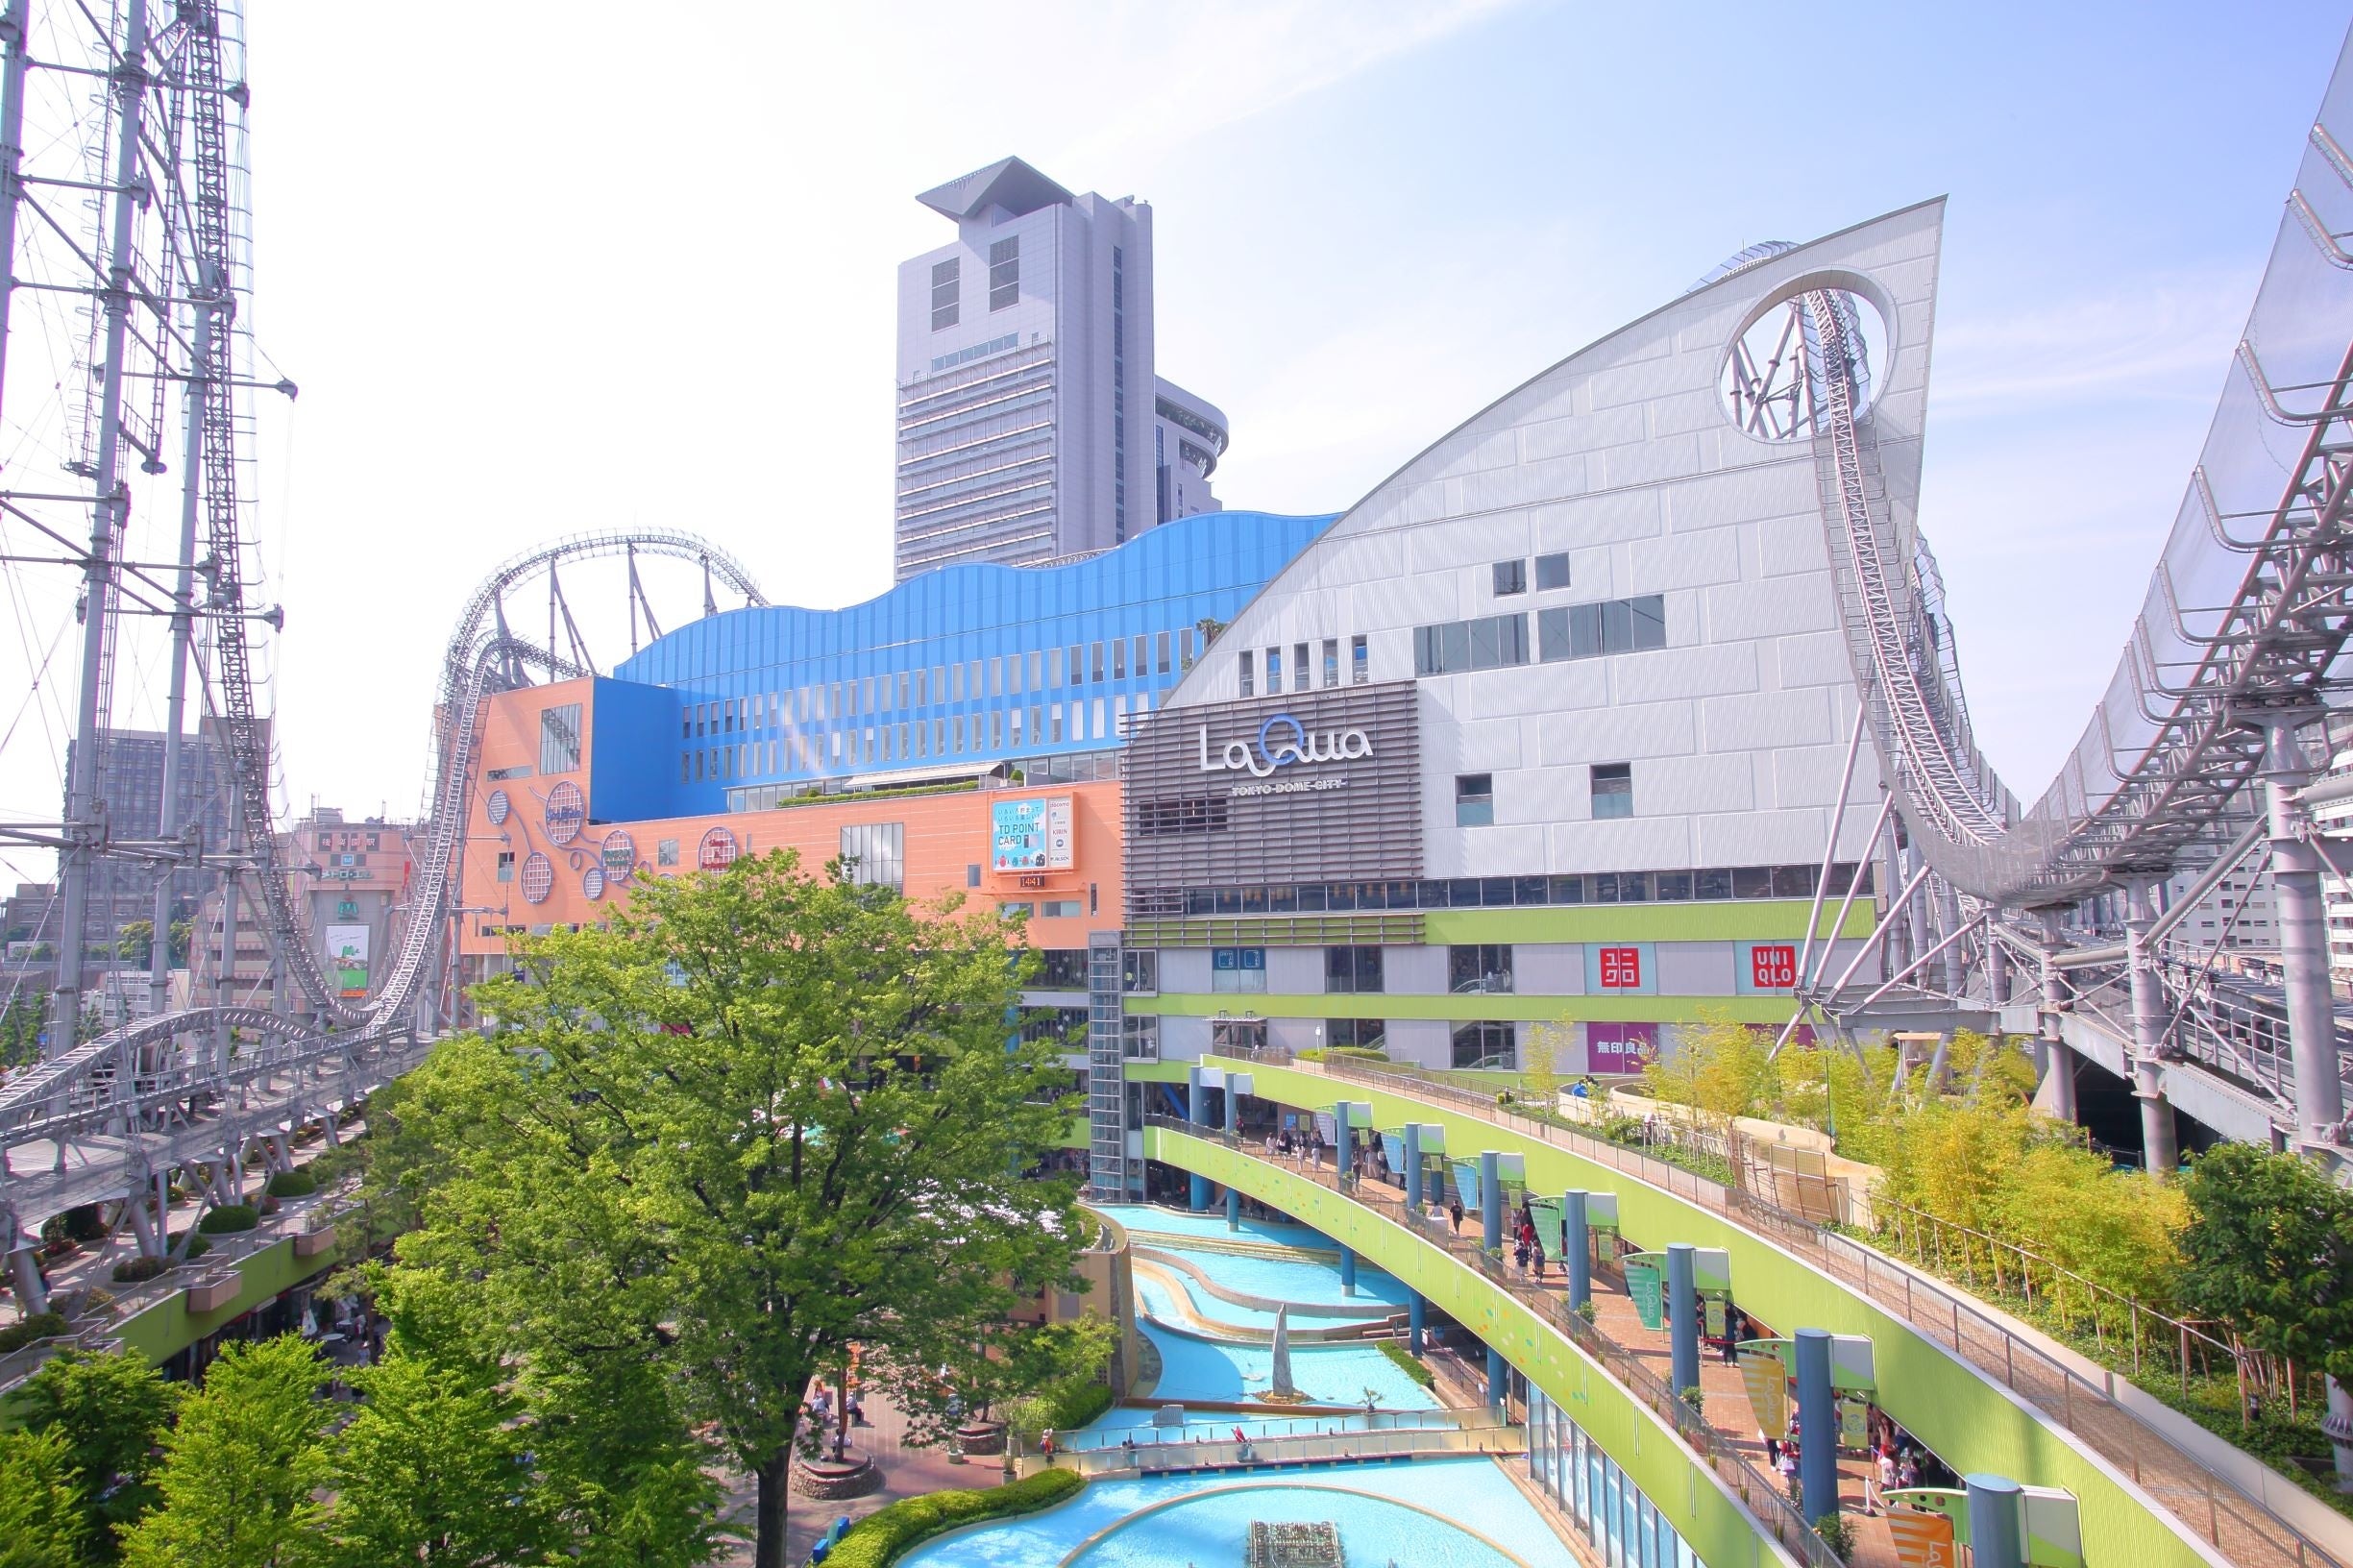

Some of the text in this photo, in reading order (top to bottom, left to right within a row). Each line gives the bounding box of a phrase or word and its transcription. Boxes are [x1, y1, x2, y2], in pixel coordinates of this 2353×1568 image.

[1200, 713, 1374, 777] LaQua
[1232, 778, 1343, 796] TOKYO DOME CITY
[998, 824, 1011, 835] TD
[1013, 822, 1040, 834] POINT
[998, 835, 1022, 845] CARD
[1021, 877, 1041, 887] 14:41
[1605, 952, 1632, 967] ユニ
[1756, 951, 1788, 967] UNI
[1605, 969, 1635, 983] クロ
[1757, 968, 1792, 984] QLO
[1597, 1041, 1649, 1055] 無印良品
